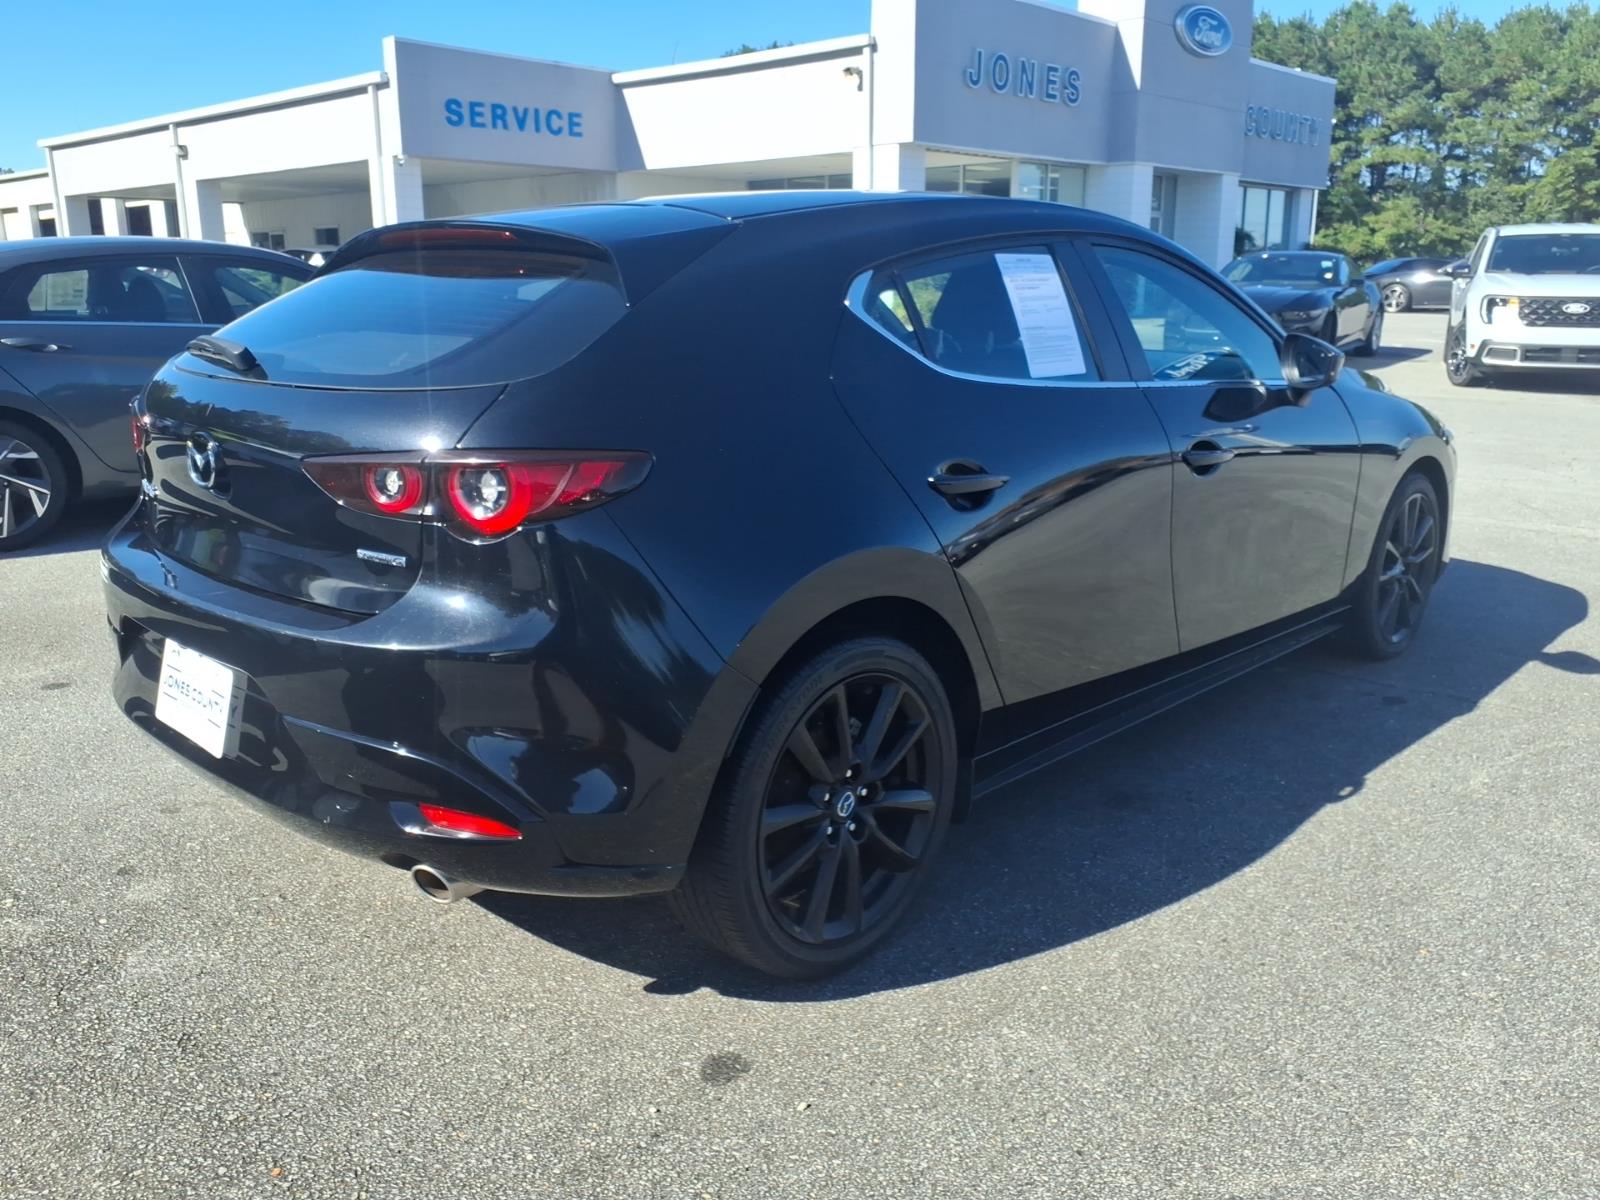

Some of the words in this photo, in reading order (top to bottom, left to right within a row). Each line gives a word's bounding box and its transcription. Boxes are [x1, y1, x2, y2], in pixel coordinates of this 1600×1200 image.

[1193, 14, 1226, 47] Ford
[965, 48, 1082, 106] JONES
[444, 98, 583, 137] SERVICE
[1244, 104, 1323, 146] COUNTY
[163, 673, 191, 695] JONES
